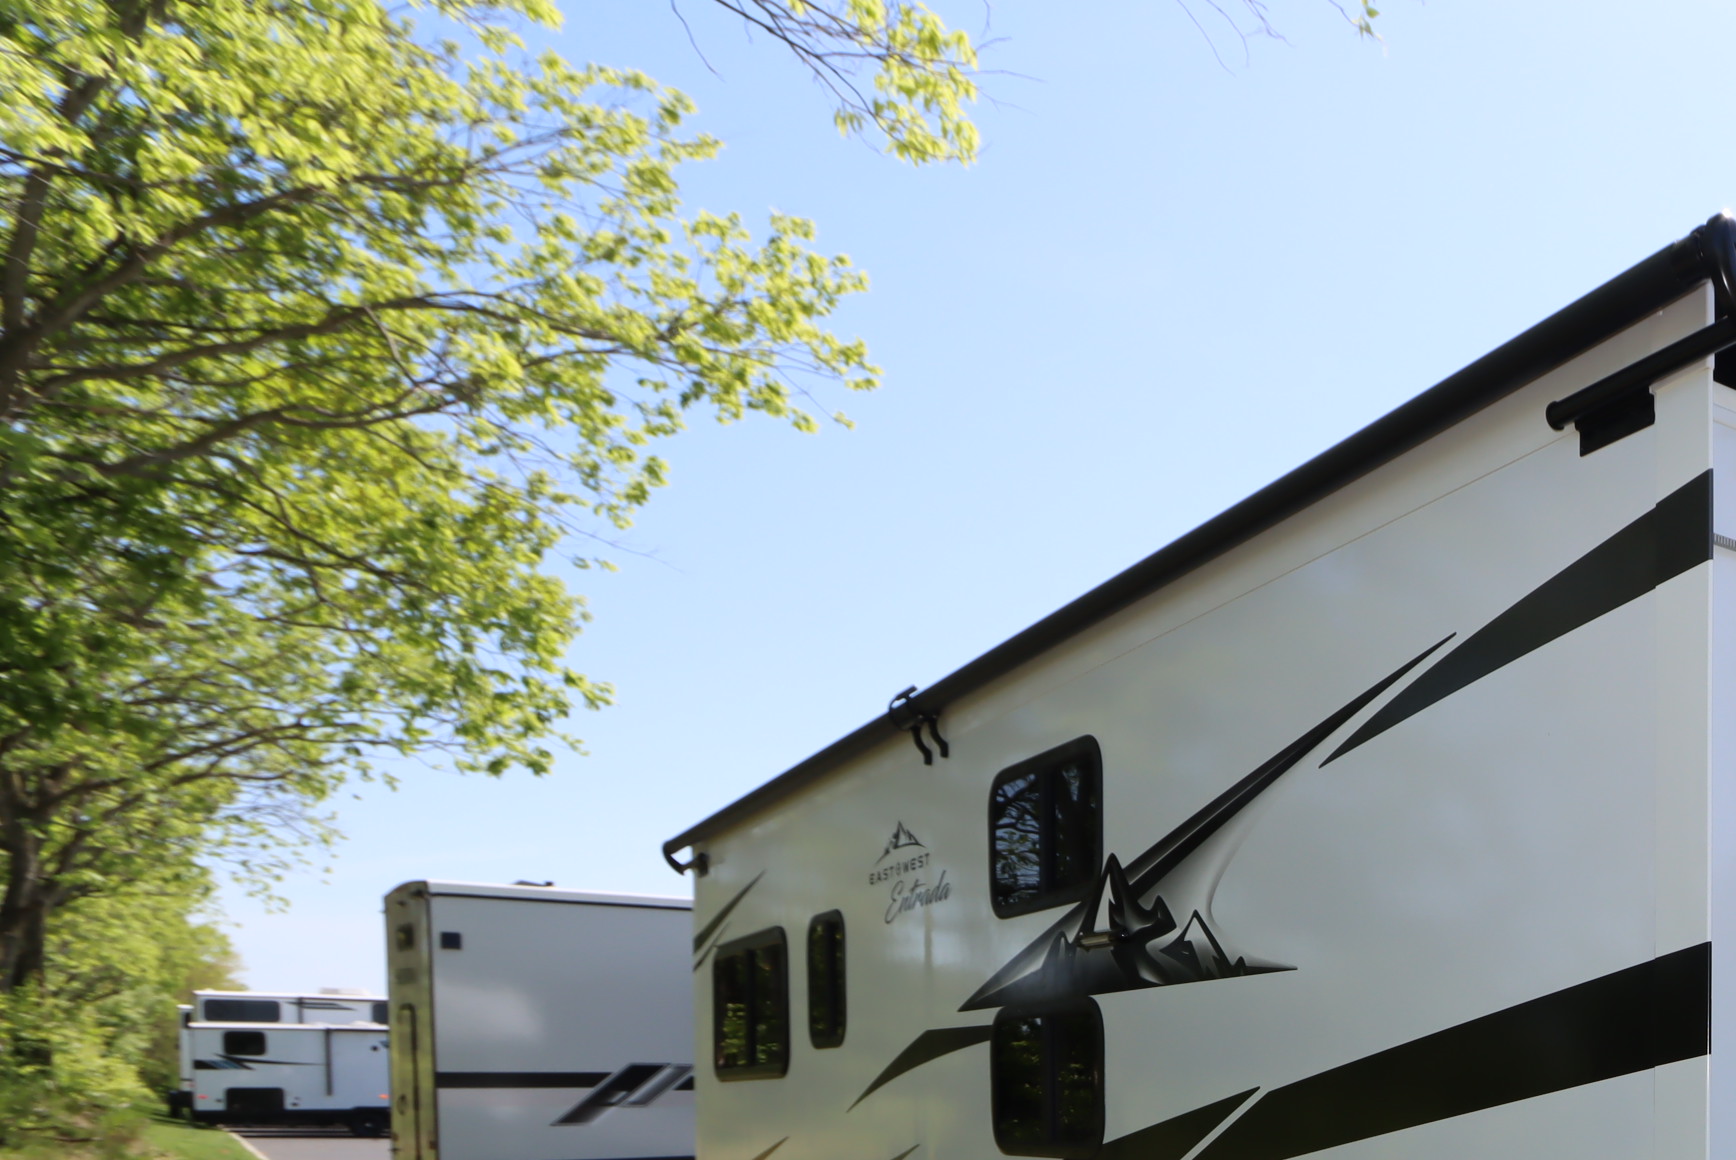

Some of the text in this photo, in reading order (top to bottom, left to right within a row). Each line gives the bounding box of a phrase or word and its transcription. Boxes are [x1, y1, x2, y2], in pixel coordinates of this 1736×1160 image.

[869, 865, 894, 886] EAST
[903, 852, 930, 873] WEST
[884, 869, 950, 924] Entrada
